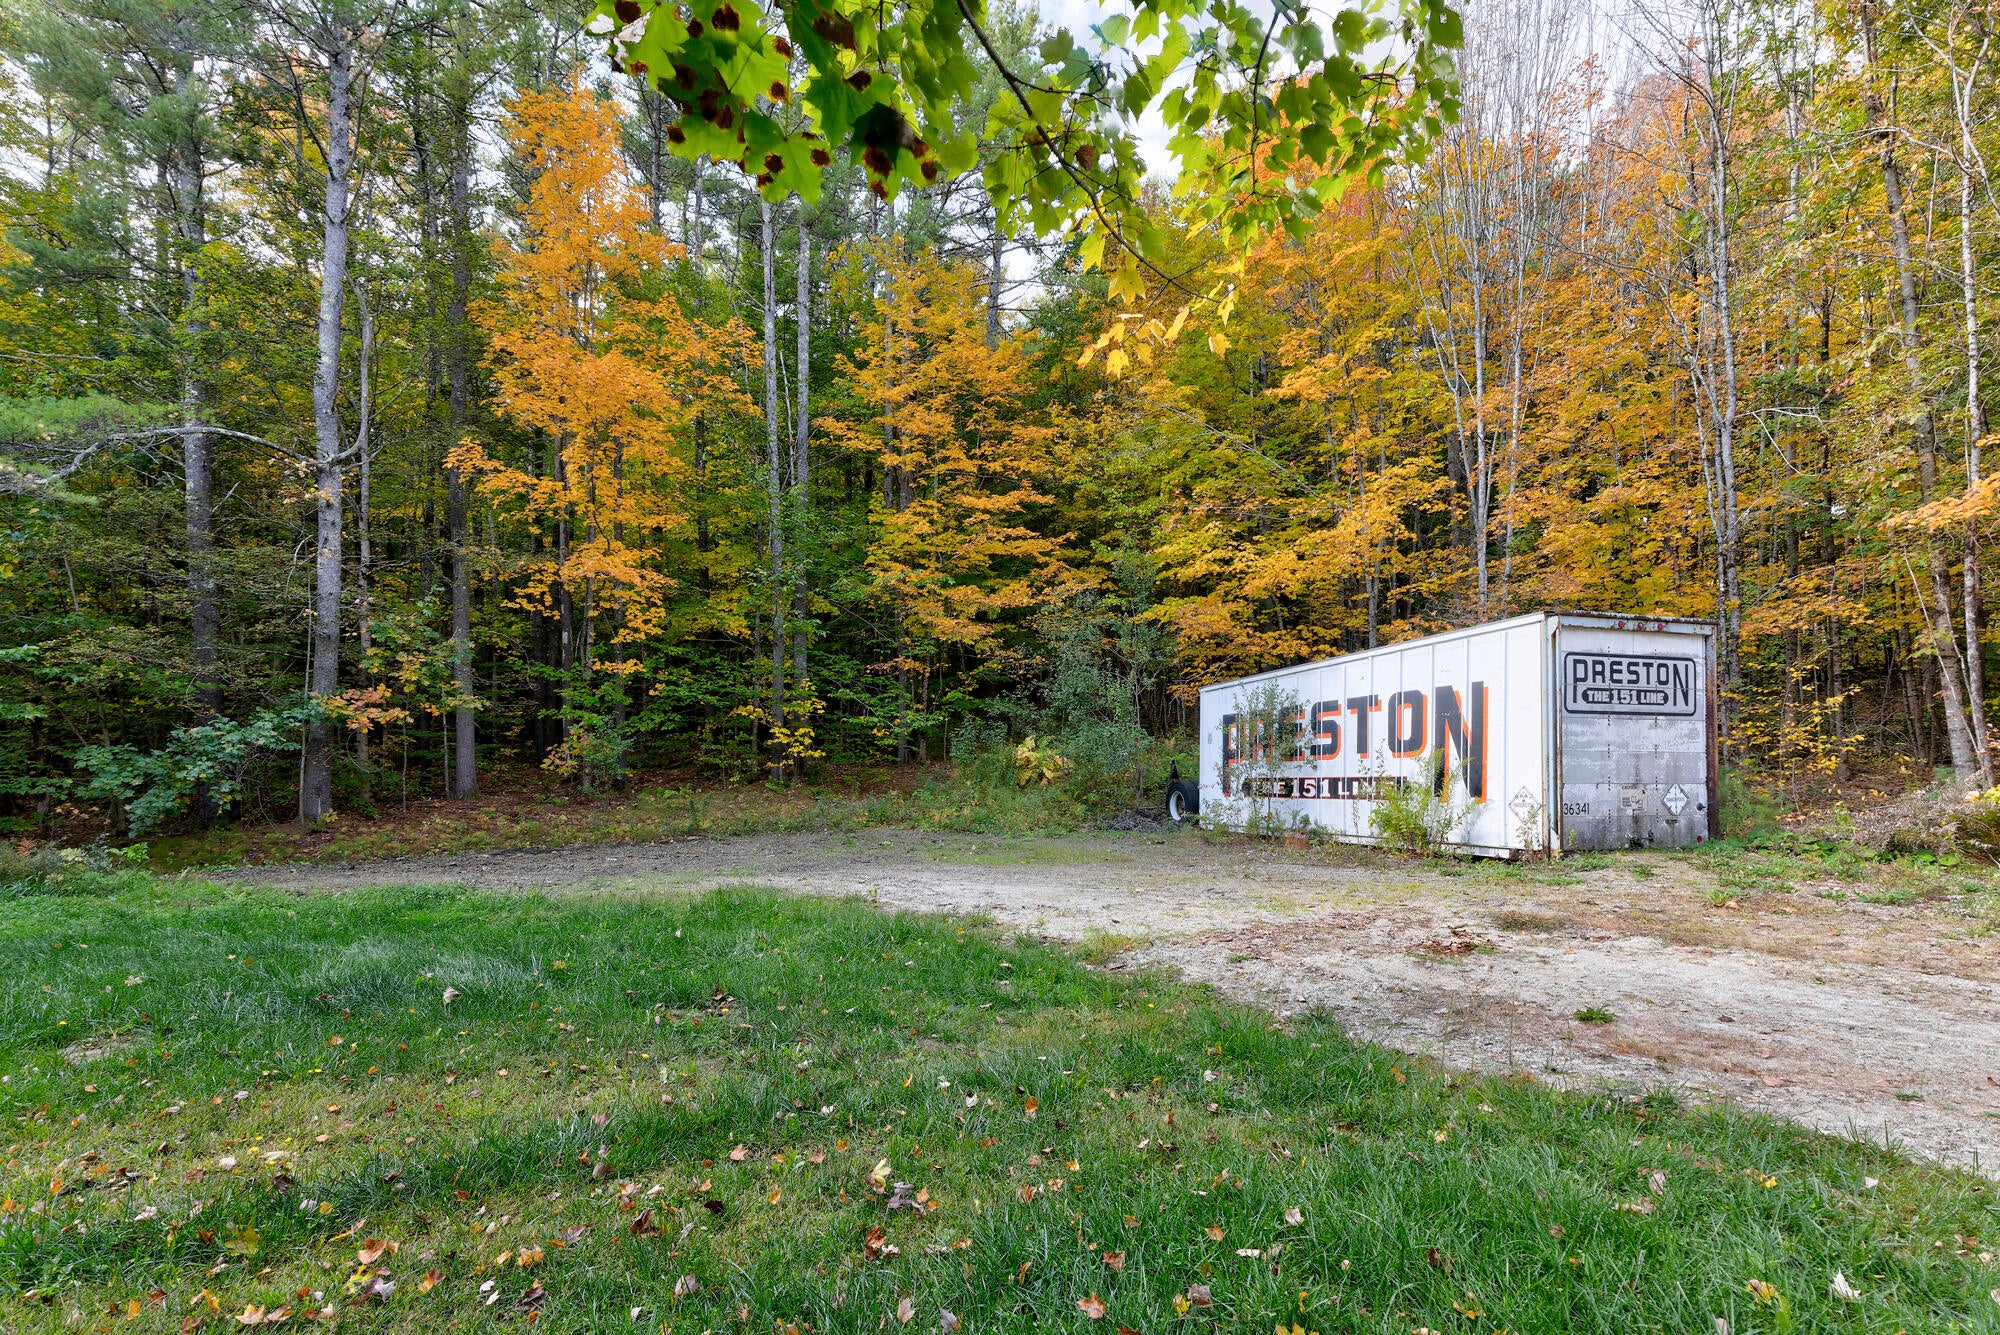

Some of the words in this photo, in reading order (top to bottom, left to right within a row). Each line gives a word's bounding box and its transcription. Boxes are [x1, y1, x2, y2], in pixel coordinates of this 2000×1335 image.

[1573, 659, 1689, 706] PRESTON
[1587, 690, 1610, 702] THE
[1611, 690, 1638, 704] 151
[1641, 692, 1665, 704] LINE
[1291, 778, 1331, 798] 151
[1563, 802, 1590, 816] 36341
